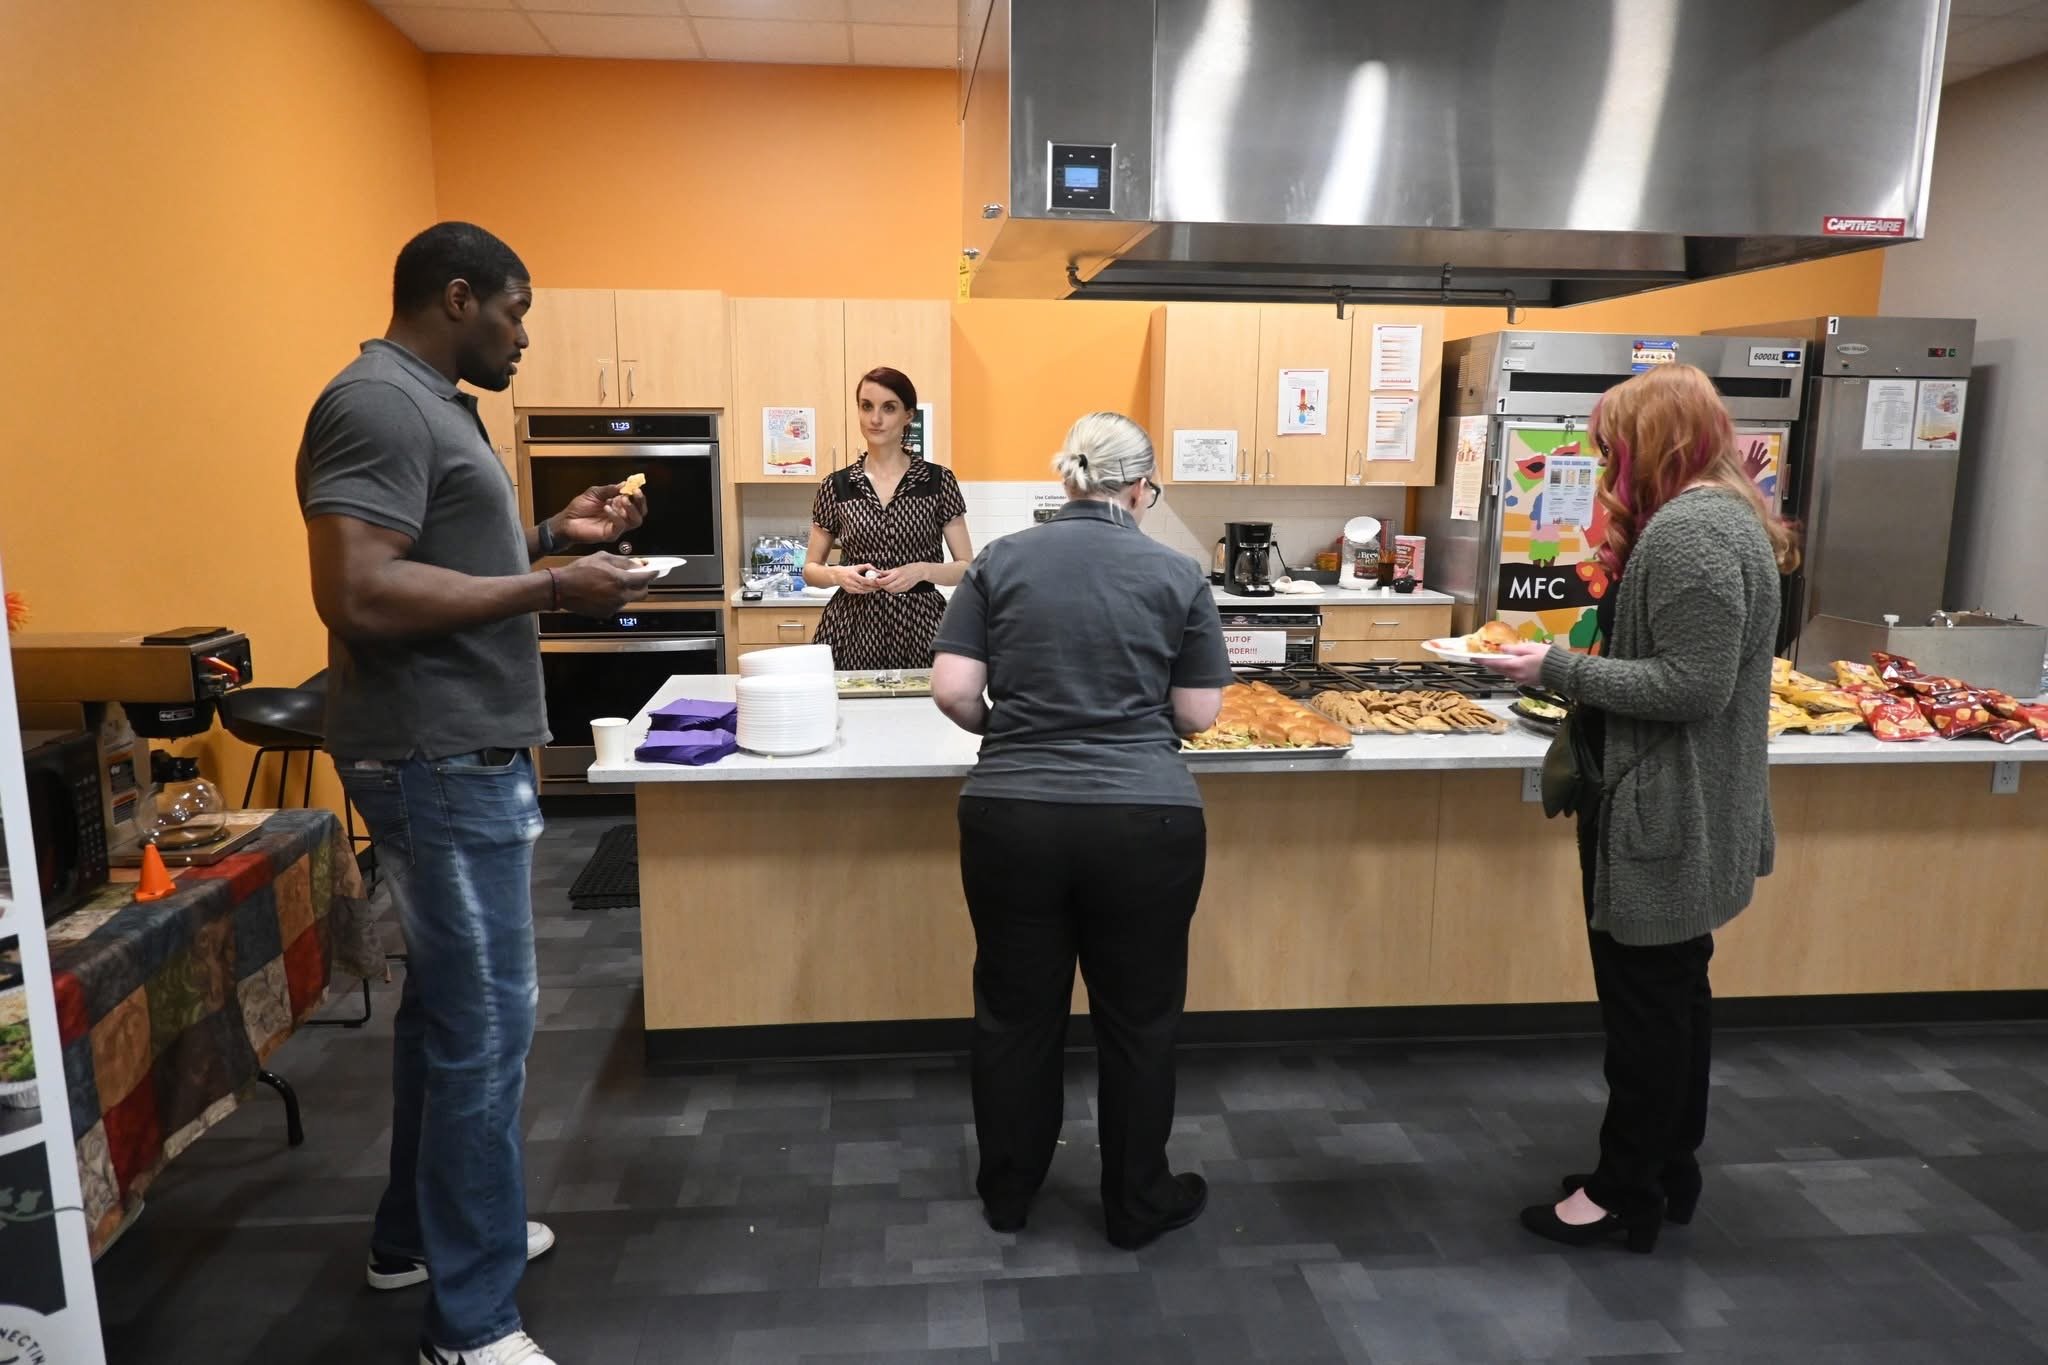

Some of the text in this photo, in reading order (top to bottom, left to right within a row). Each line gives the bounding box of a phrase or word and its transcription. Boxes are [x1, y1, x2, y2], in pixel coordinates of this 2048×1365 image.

[1829, 318, 1838, 334] 1
[1498, 398, 1506, 413] 1
[610, 422, 630, 430] 11:23
[1509, 576, 1566, 599] MFC
[619, 617, 637, 625] 11:21
[1227, 647, 1257, 655] RDER!!!
